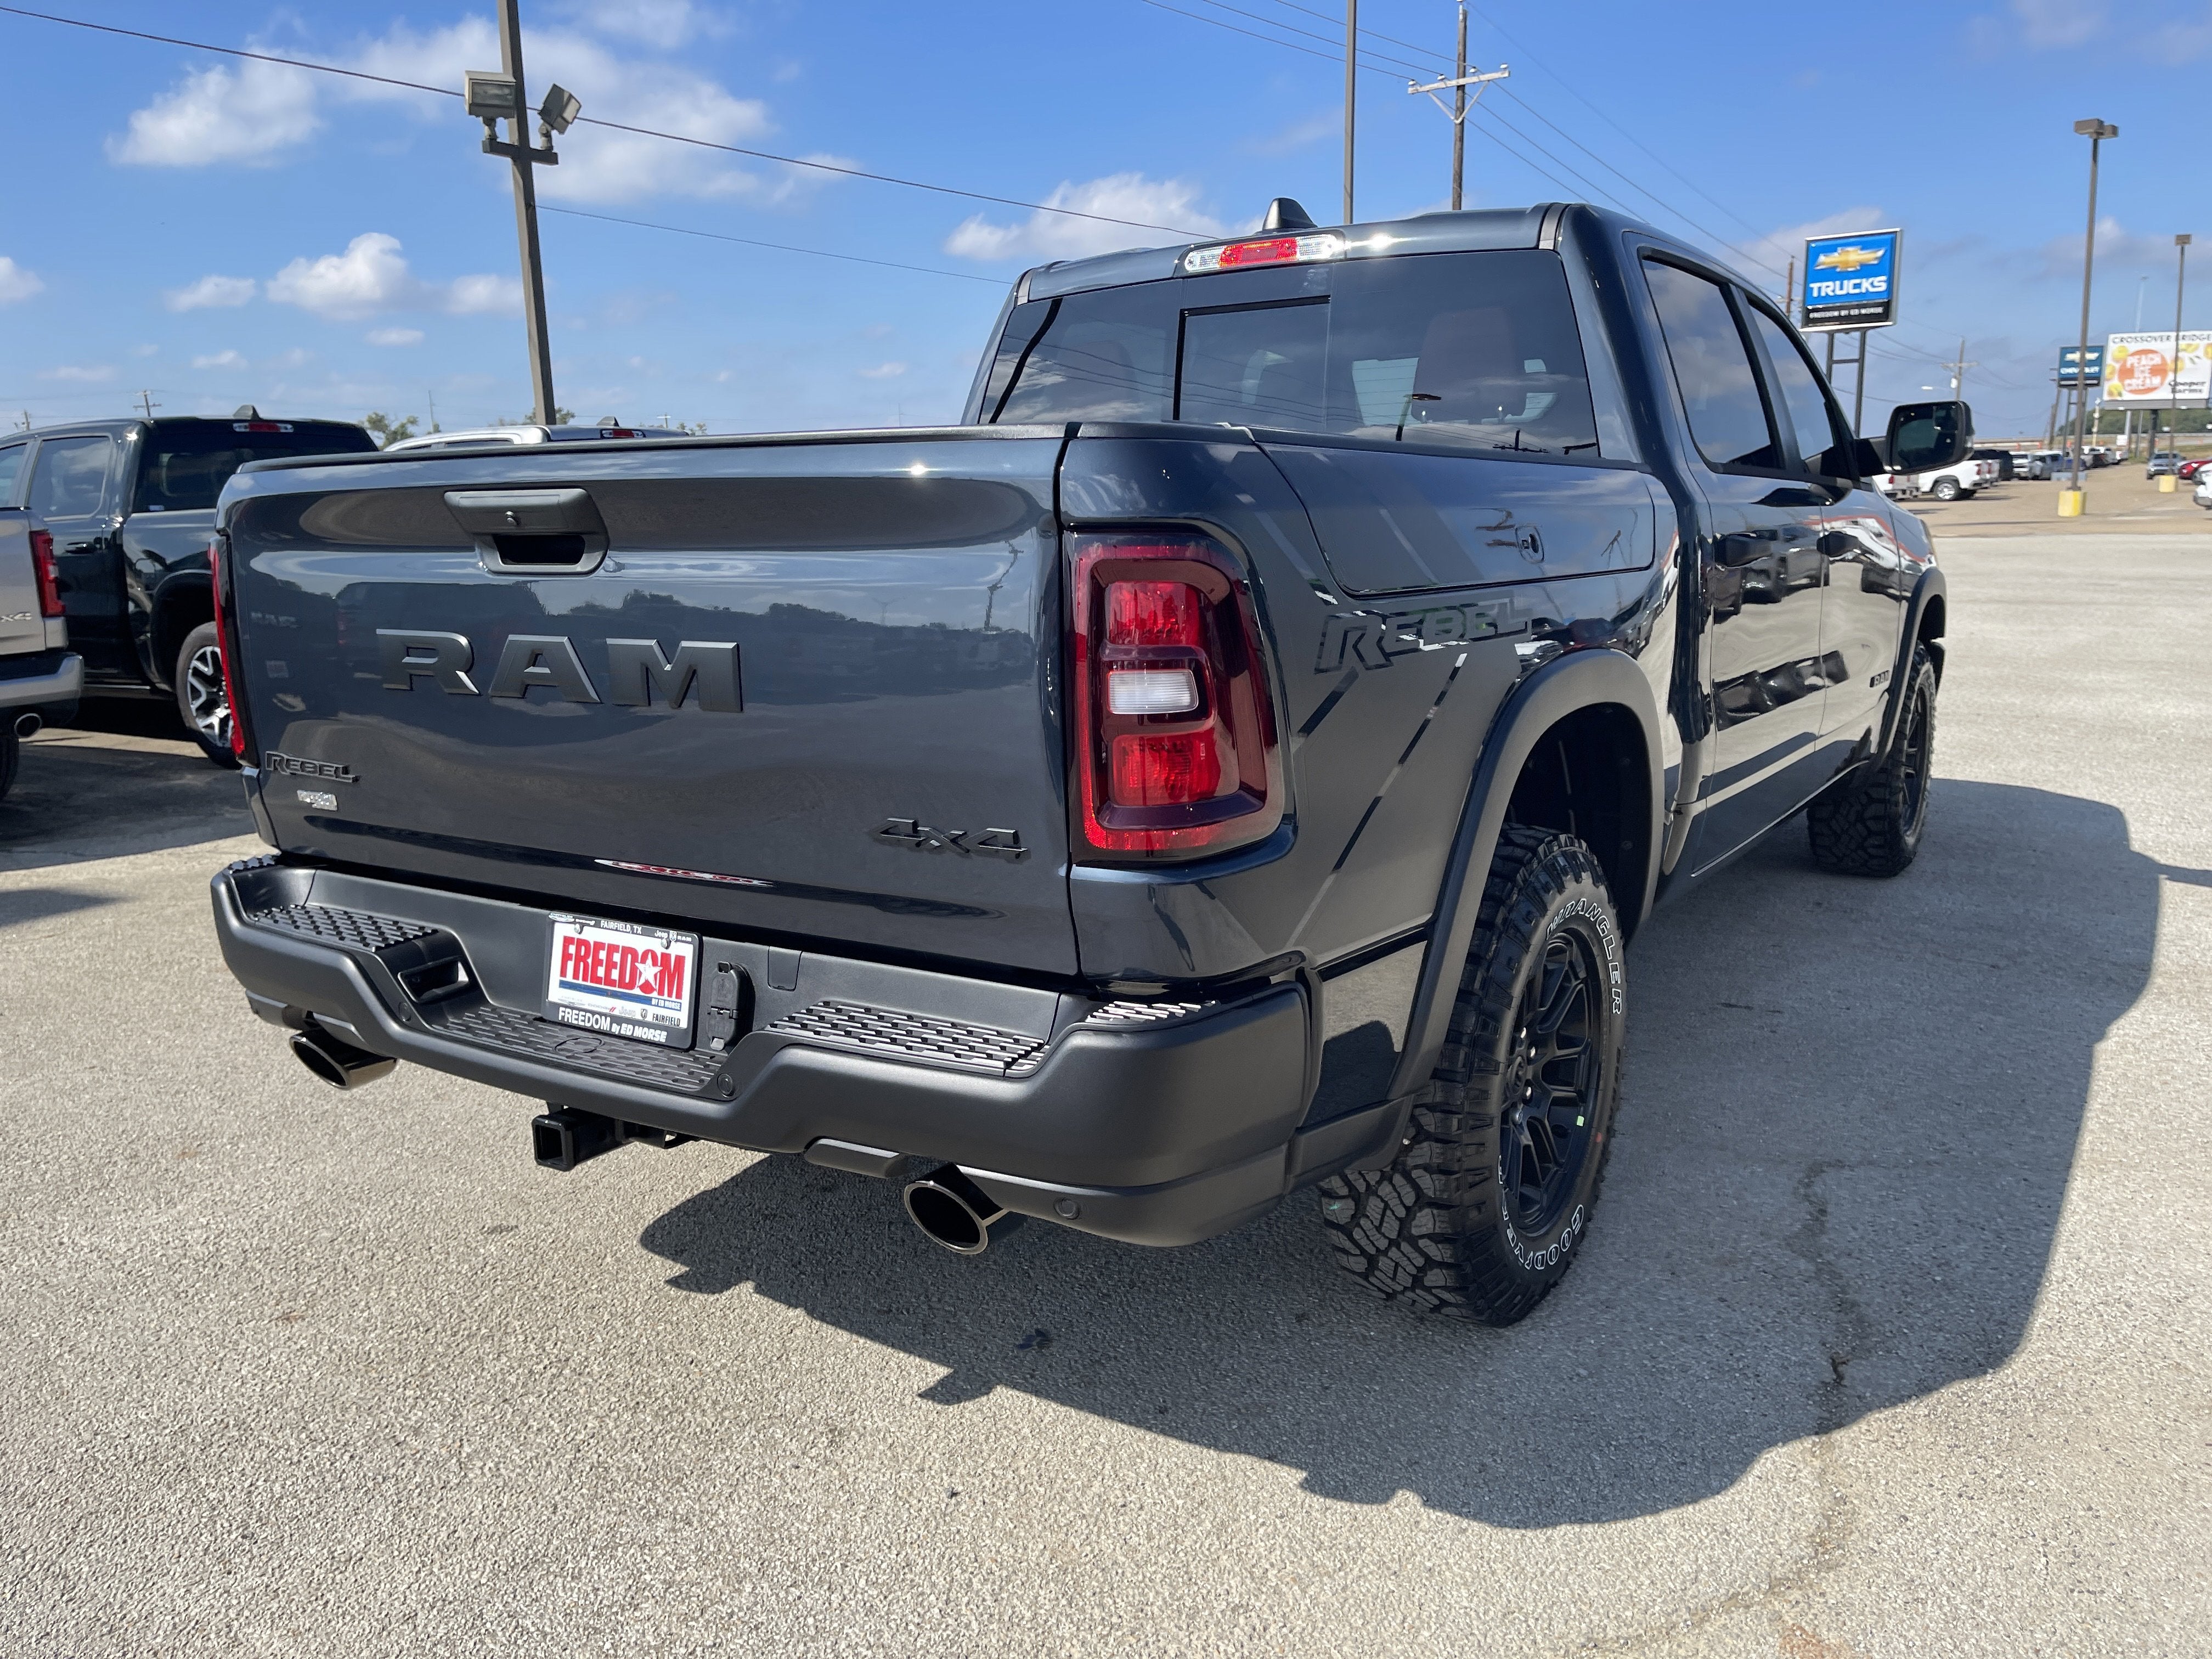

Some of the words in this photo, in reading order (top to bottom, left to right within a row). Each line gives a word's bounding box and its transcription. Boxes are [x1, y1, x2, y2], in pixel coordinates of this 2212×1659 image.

[1809, 275, 1888, 298] TRUCKS
[2112, 335, 2171, 343] CROSSOVER
[2176, 333, 2212, 341] RIDGE
[2126, 353, 2162, 369] PEACH
[2060, 366, 2100, 374] CHEVLET
[2134, 365, 2151, 379] ICE
[2124, 376, 2162, 391] CREAM
[1314, 595, 1532, 675] REBEL
[376, 629, 744, 712] RAM
[266, 751, 356, 783] REBEL
[633, 925, 642, 934] TX
[654, 929, 668, 939] Jeep
[1546, 898, 1622, 1014] WRANGLER
[559, 935, 686, 1000] FREEDOM
[619, 1006, 636, 1018] Jeep
[664, 1001, 681, 1010] MORSE
[558, 1007, 611, 1031] FREEDOM
[620, 1023, 633, 1036] ED
[633, 1025, 668, 1043] MORSE
[652, 1012, 681, 1027] FAIRFIELD
